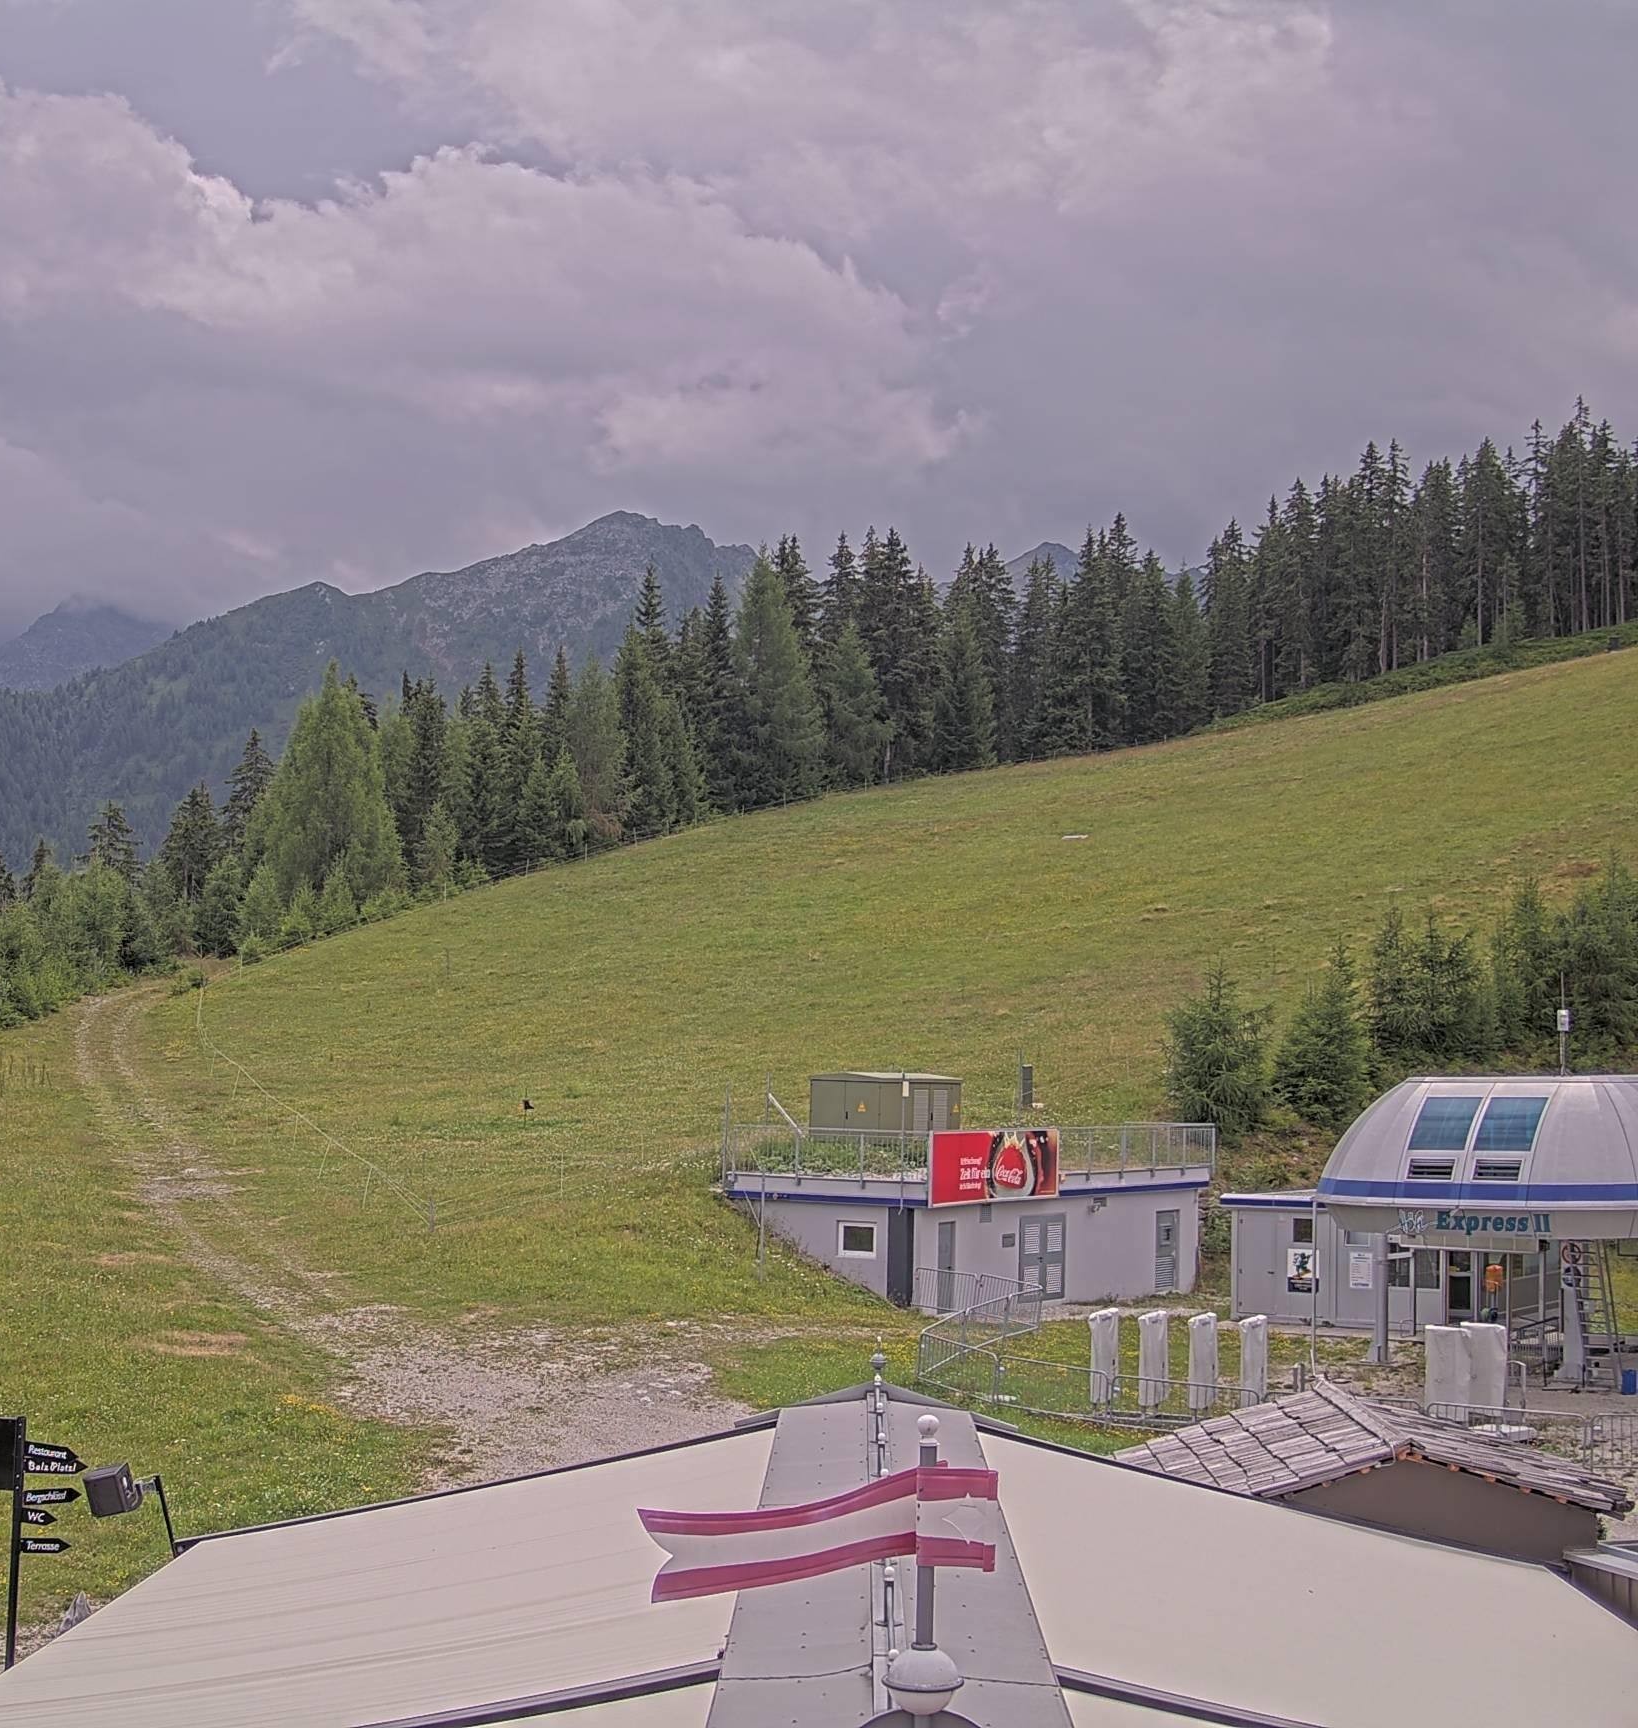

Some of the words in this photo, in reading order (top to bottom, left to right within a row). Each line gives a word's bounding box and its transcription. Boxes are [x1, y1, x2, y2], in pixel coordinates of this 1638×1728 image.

[1436, 1210, 1529, 1235] Express
[1533, 1213, 1551, 1232] II
[28, 1445, 67, 1459] Restaurant
[27, 1511, 46, 1523] WC
[26, 1540, 60, 1552] Terrasse
